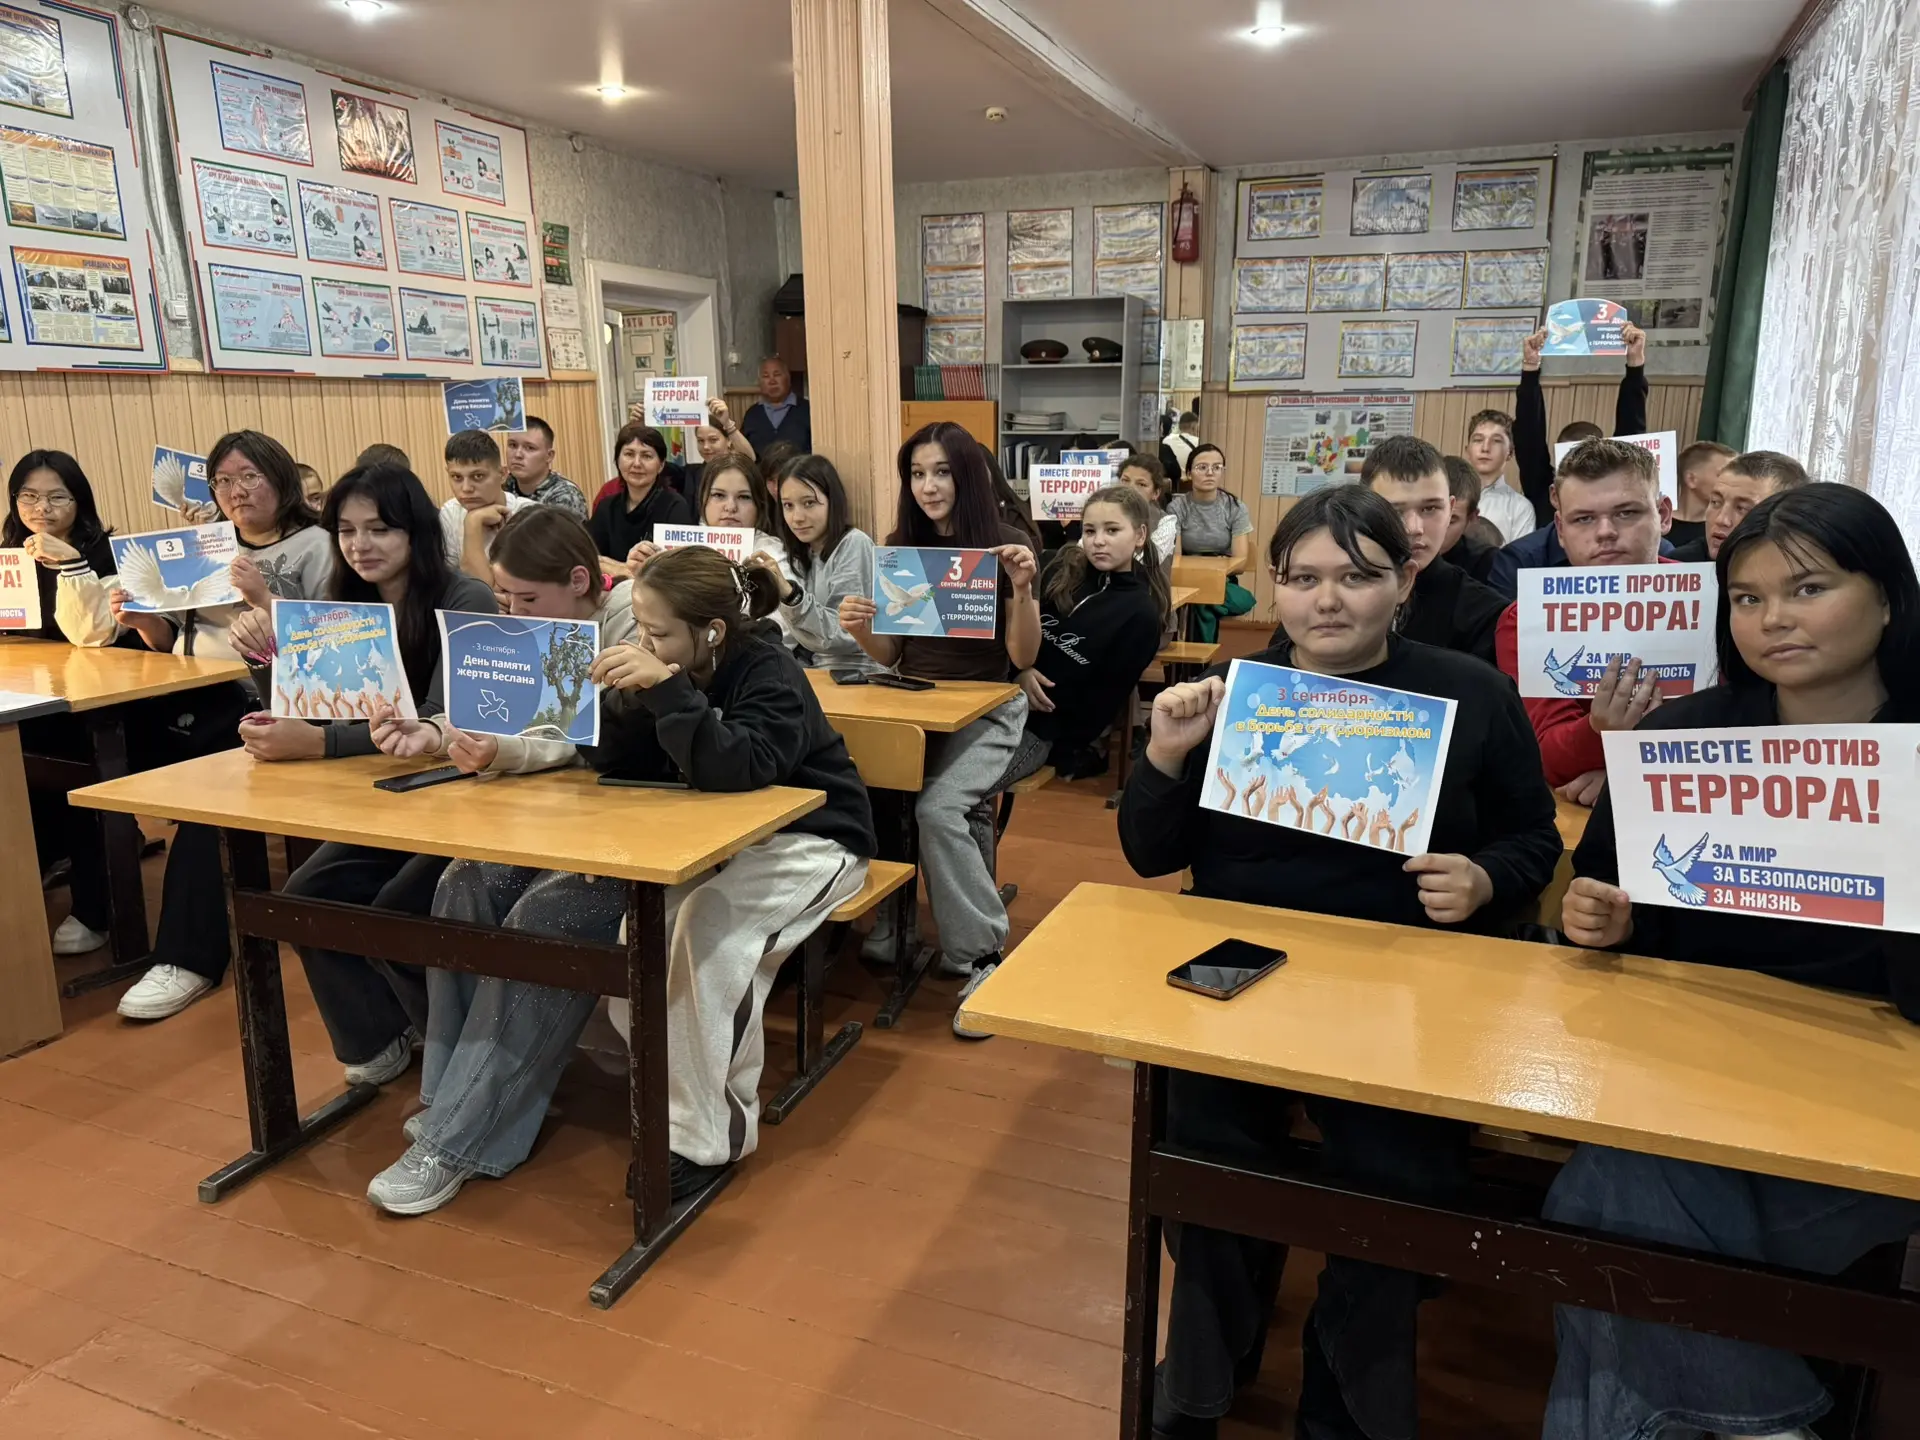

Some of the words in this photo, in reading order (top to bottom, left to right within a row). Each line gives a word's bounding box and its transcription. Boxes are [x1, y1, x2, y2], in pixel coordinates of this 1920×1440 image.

[1597, 304, 1608, 319] 3
[652, 390, 699, 401] ТЕРРОРА!
[197, 464, 204, 473] 3
[1040, 469, 1070, 477] ВМЕСТЕ
[1071, 469, 1101, 477] ПРОТИВ
[1040, 480, 1100, 493] ТЕРРОРА!
[665, 530, 704, 543] ВМЕСТЕ
[707, 532, 742, 545] ПРОТИВ
[165, 541, 174, 552] 3
[949, 556, 962, 580] 3
[0, 570, 22, 588] А!
[941, 581, 967, 589] сентября
[970, 579, 994, 589] ДЕНЬ
[1543, 575, 1620, 595] ВМЕСТЕ
[1626, 573, 1702, 593] ПРОТИВ
[951, 593, 994, 601] солидарности
[964, 602, 993, 613] борьбе
[947, 613, 992, 622] ТЕРРОРИЗМОМ
[1542, 600, 1700, 632] ТЕРРОРА!
[482, 643, 516, 655] сентября
[463, 655, 489, 666] День
[491, 660, 531, 672] памяти
[1586, 653, 1601, 664] ЗА
[457, 668, 490, 680] жертв
[492, 672, 535, 685] Беслана
[1586, 668, 1601, 679] ЗА
[1277, 688, 1286, 701] 3
[1292, 690, 1374, 706] сентября-
[1256, 704, 1296, 717] День
[1299, 707, 1414, 722] солидарности
[1235, 722, 1245, 731] в
[1247, 719, 1303, 734] борьбе
[1307, 725, 1316, 734] с
[1639, 739, 1753, 764] ВМЕСТЕ
[1762, 738, 1880, 766] ПРОТИВ
[1643, 773, 1880, 824] ТЕРРОРА!
[1712, 843, 1734, 860] ЗА
[1739, 846, 1777, 863] МИР
[1713, 866, 1735, 883] ЗА
[1740, 868, 1876, 896] БЕЗОПАСНОСТЬ
[1713, 888, 1735, 905] ЗА
[1740, 891, 1801, 912] ЖИЗНЬ
